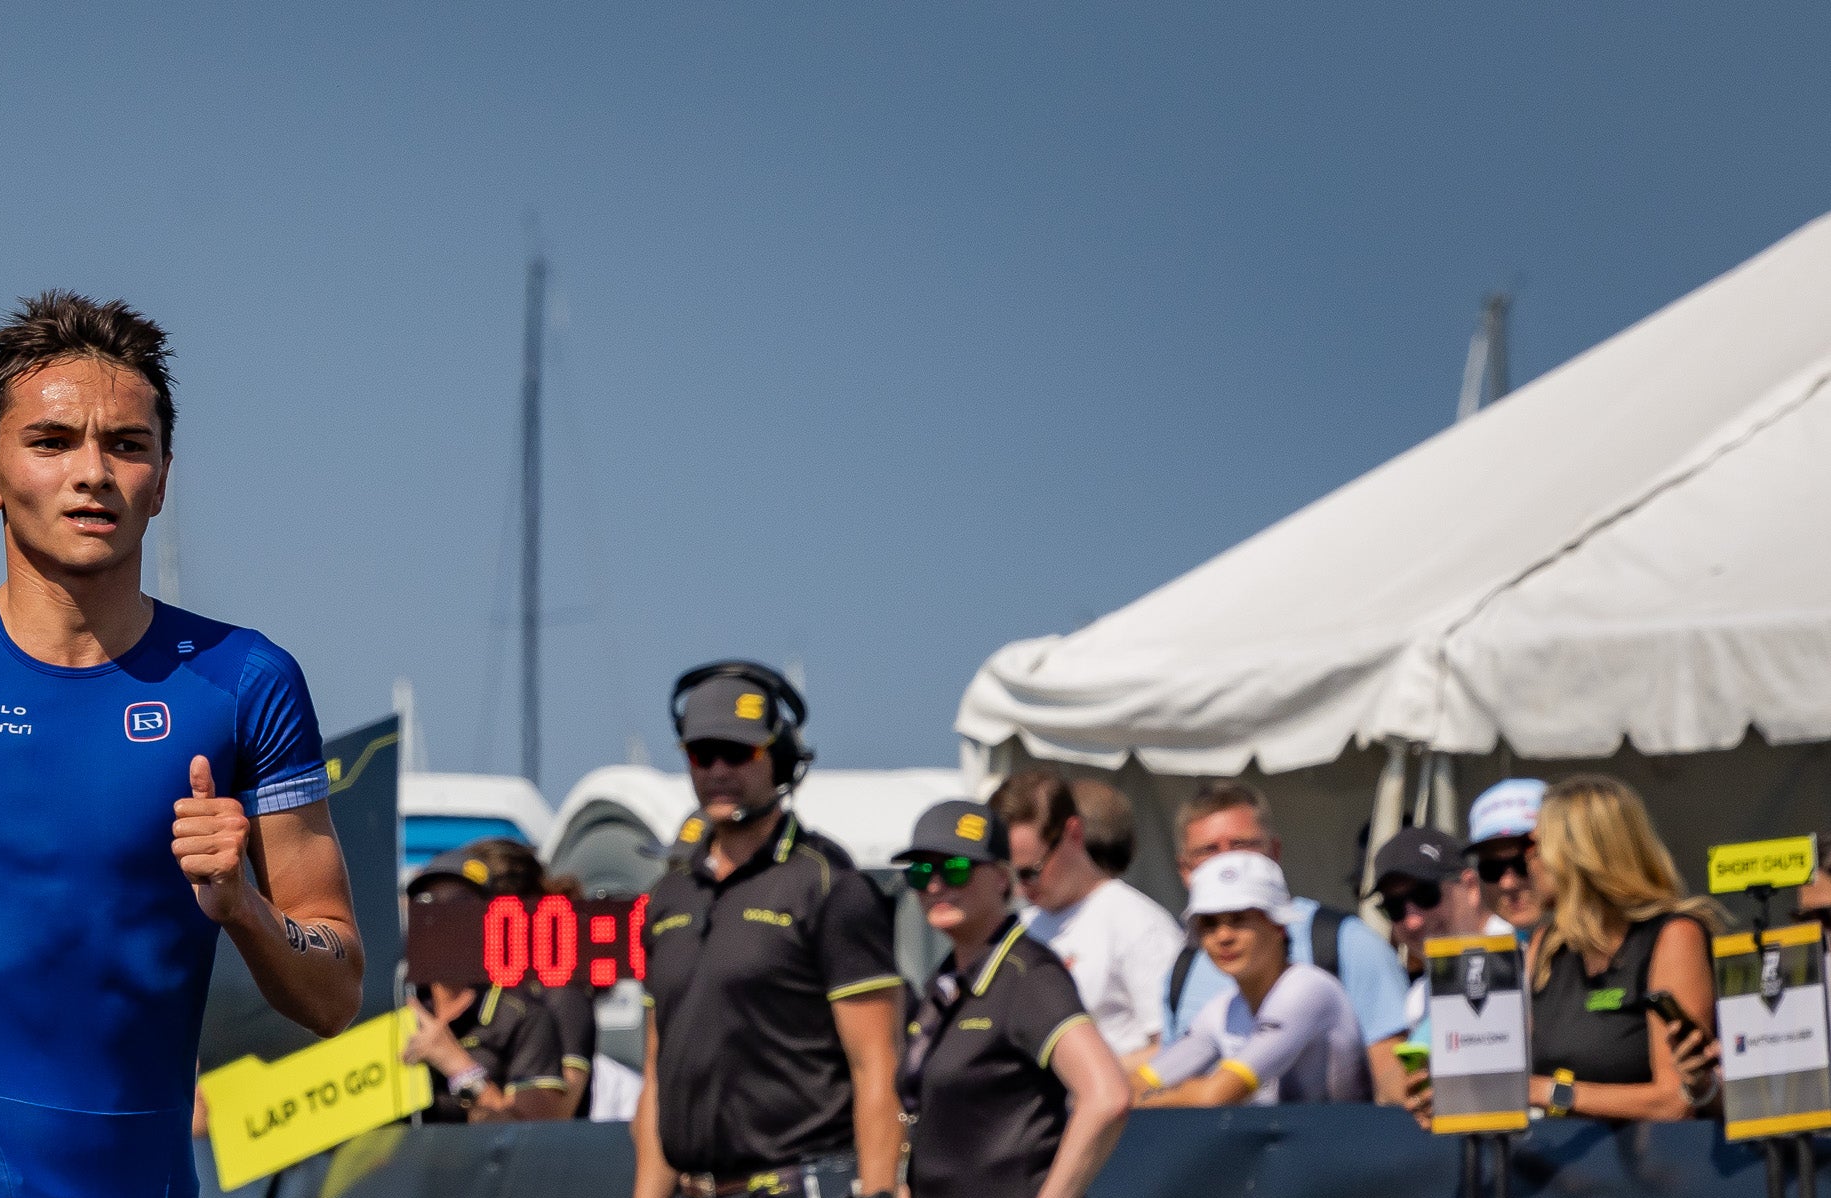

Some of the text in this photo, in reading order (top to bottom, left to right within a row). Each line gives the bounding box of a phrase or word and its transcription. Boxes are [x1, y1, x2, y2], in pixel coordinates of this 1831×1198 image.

[244, 1061, 386, 1140] LAP TO GO
